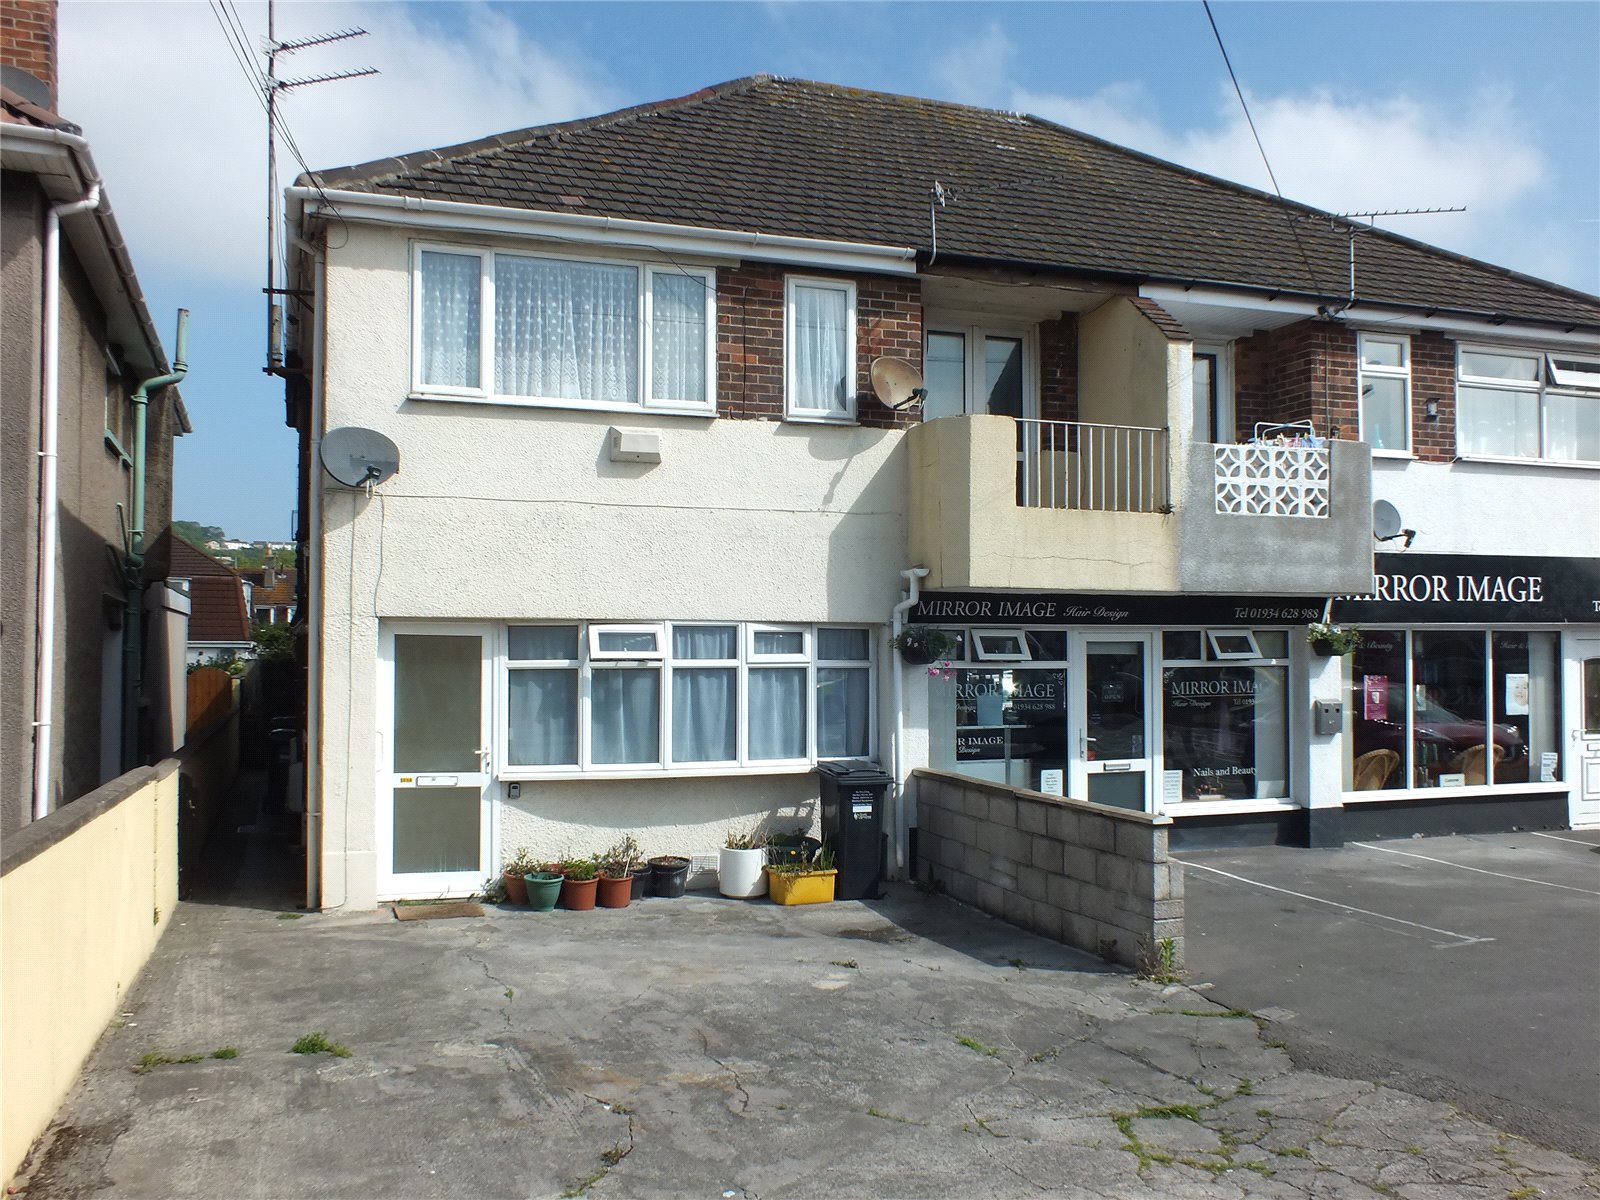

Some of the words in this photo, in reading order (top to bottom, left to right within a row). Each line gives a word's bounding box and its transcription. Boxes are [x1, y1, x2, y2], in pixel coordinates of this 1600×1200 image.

[1335, 574, 1451, 602] RROR
[1456, 575, 1544, 602] IMAGE
[917, 600, 992, 616] MIRROR
[998, 601, 1057, 617] IMAGE
[1063, 605, 1091, 617] Hair
[1092, 605, 1129, 621] Design
[1234, 607, 1249, 618] Tel
[1250, 607, 1279, 619] 01934
[1281, 607, 1299, 619] 628
[1301, 608, 1319, 619] 988
[1009, 683, 1056, 698] MAGE
[1172, 681, 1231, 696] MIRROR
[968, 736, 1004, 746] IMAGE
[1193, 767, 1214, 777] Nails
[1215, 766, 1231, 776] and
[1232, 765, 1257, 776] Beauty
